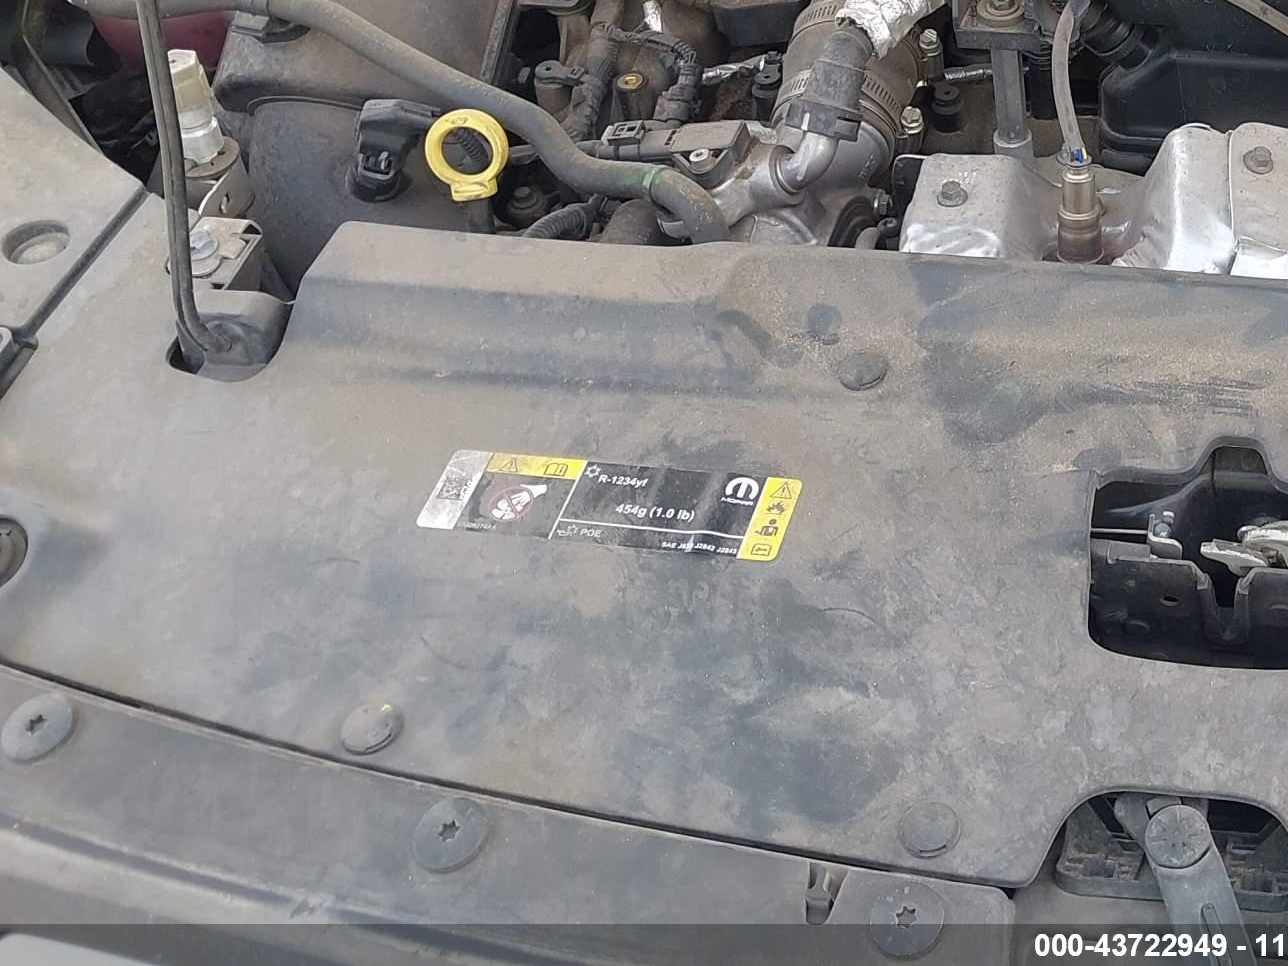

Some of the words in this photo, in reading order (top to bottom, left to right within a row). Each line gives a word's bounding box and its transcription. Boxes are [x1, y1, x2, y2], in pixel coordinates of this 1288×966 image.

[598, 474, 648, 489] R-1234yf
[615, 503, 647, 518] 454g
[649, 505, 675, 519] (1.0
[676, 508, 696, 523] lb)
[580, 528, 602, 538] POE
[661, 541, 677, 549] SAE
